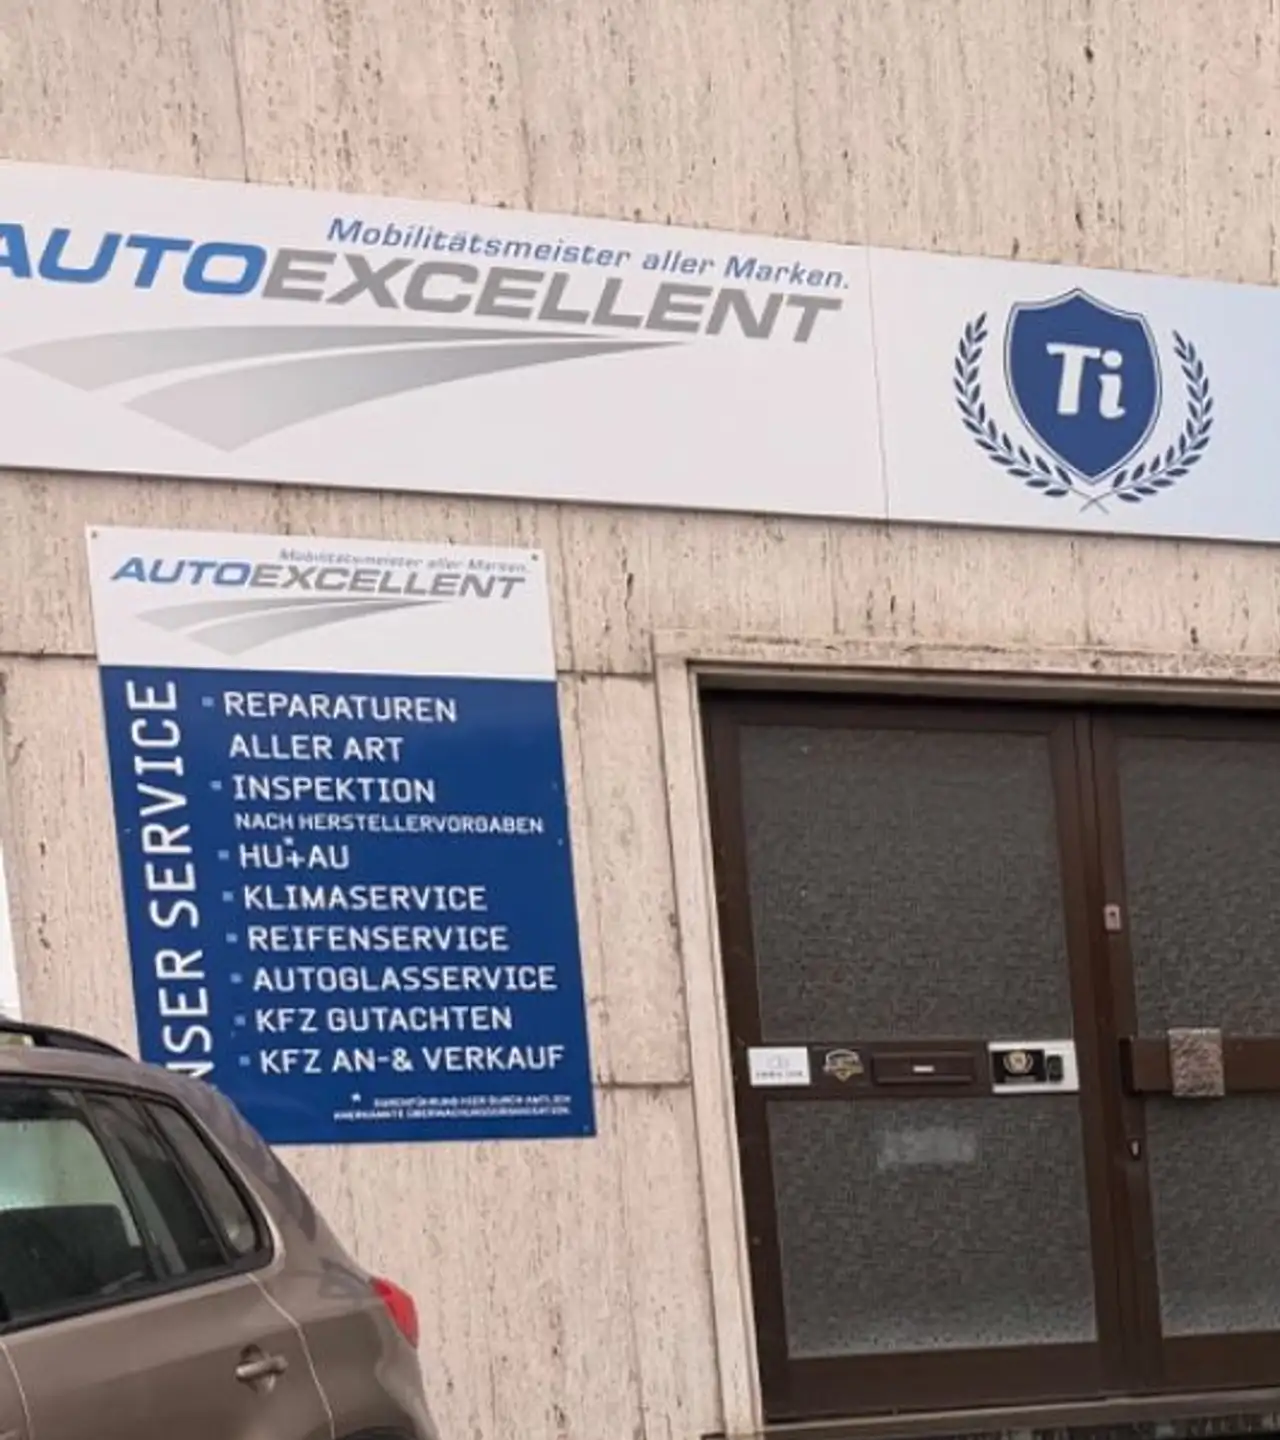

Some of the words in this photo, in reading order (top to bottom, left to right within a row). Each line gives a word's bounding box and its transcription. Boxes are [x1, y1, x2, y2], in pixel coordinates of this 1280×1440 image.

[327, 217, 631, 268] Mobilitätsmeister
[642, 252, 715, 276] aller
[723, 255, 850, 290] Marken.
[1046, 341, 1126, 420] Ti
[110, 556, 527, 599] AUTOEXCELLENT
[223, 691, 458, 722] REPARATUREN
[229, 734, 333, 761] ALLER
[343, 736, 404, 762] ART
[232, 774, 436, 804] INSPEKTION
[125, 680, 200, 929] SERVICE
[234, 812, 295, 831] NACH
[298, 813, 545, 834] HERSTELLERVORGABEN
[243, 884, 489, 911] KLIMASERVICE
[246, 925, 511, 952] REIFENSERVICE
[252, 965, 558, 993] AUTOGLASSERVICE
[255, 1007, 319, 1033] KFZ
[326, 1006, 514, 1033] GUTACHTEN
[260, 1049, 323, 1074] KFZ
[422, 1045, 566, 1071] VERKAUF
